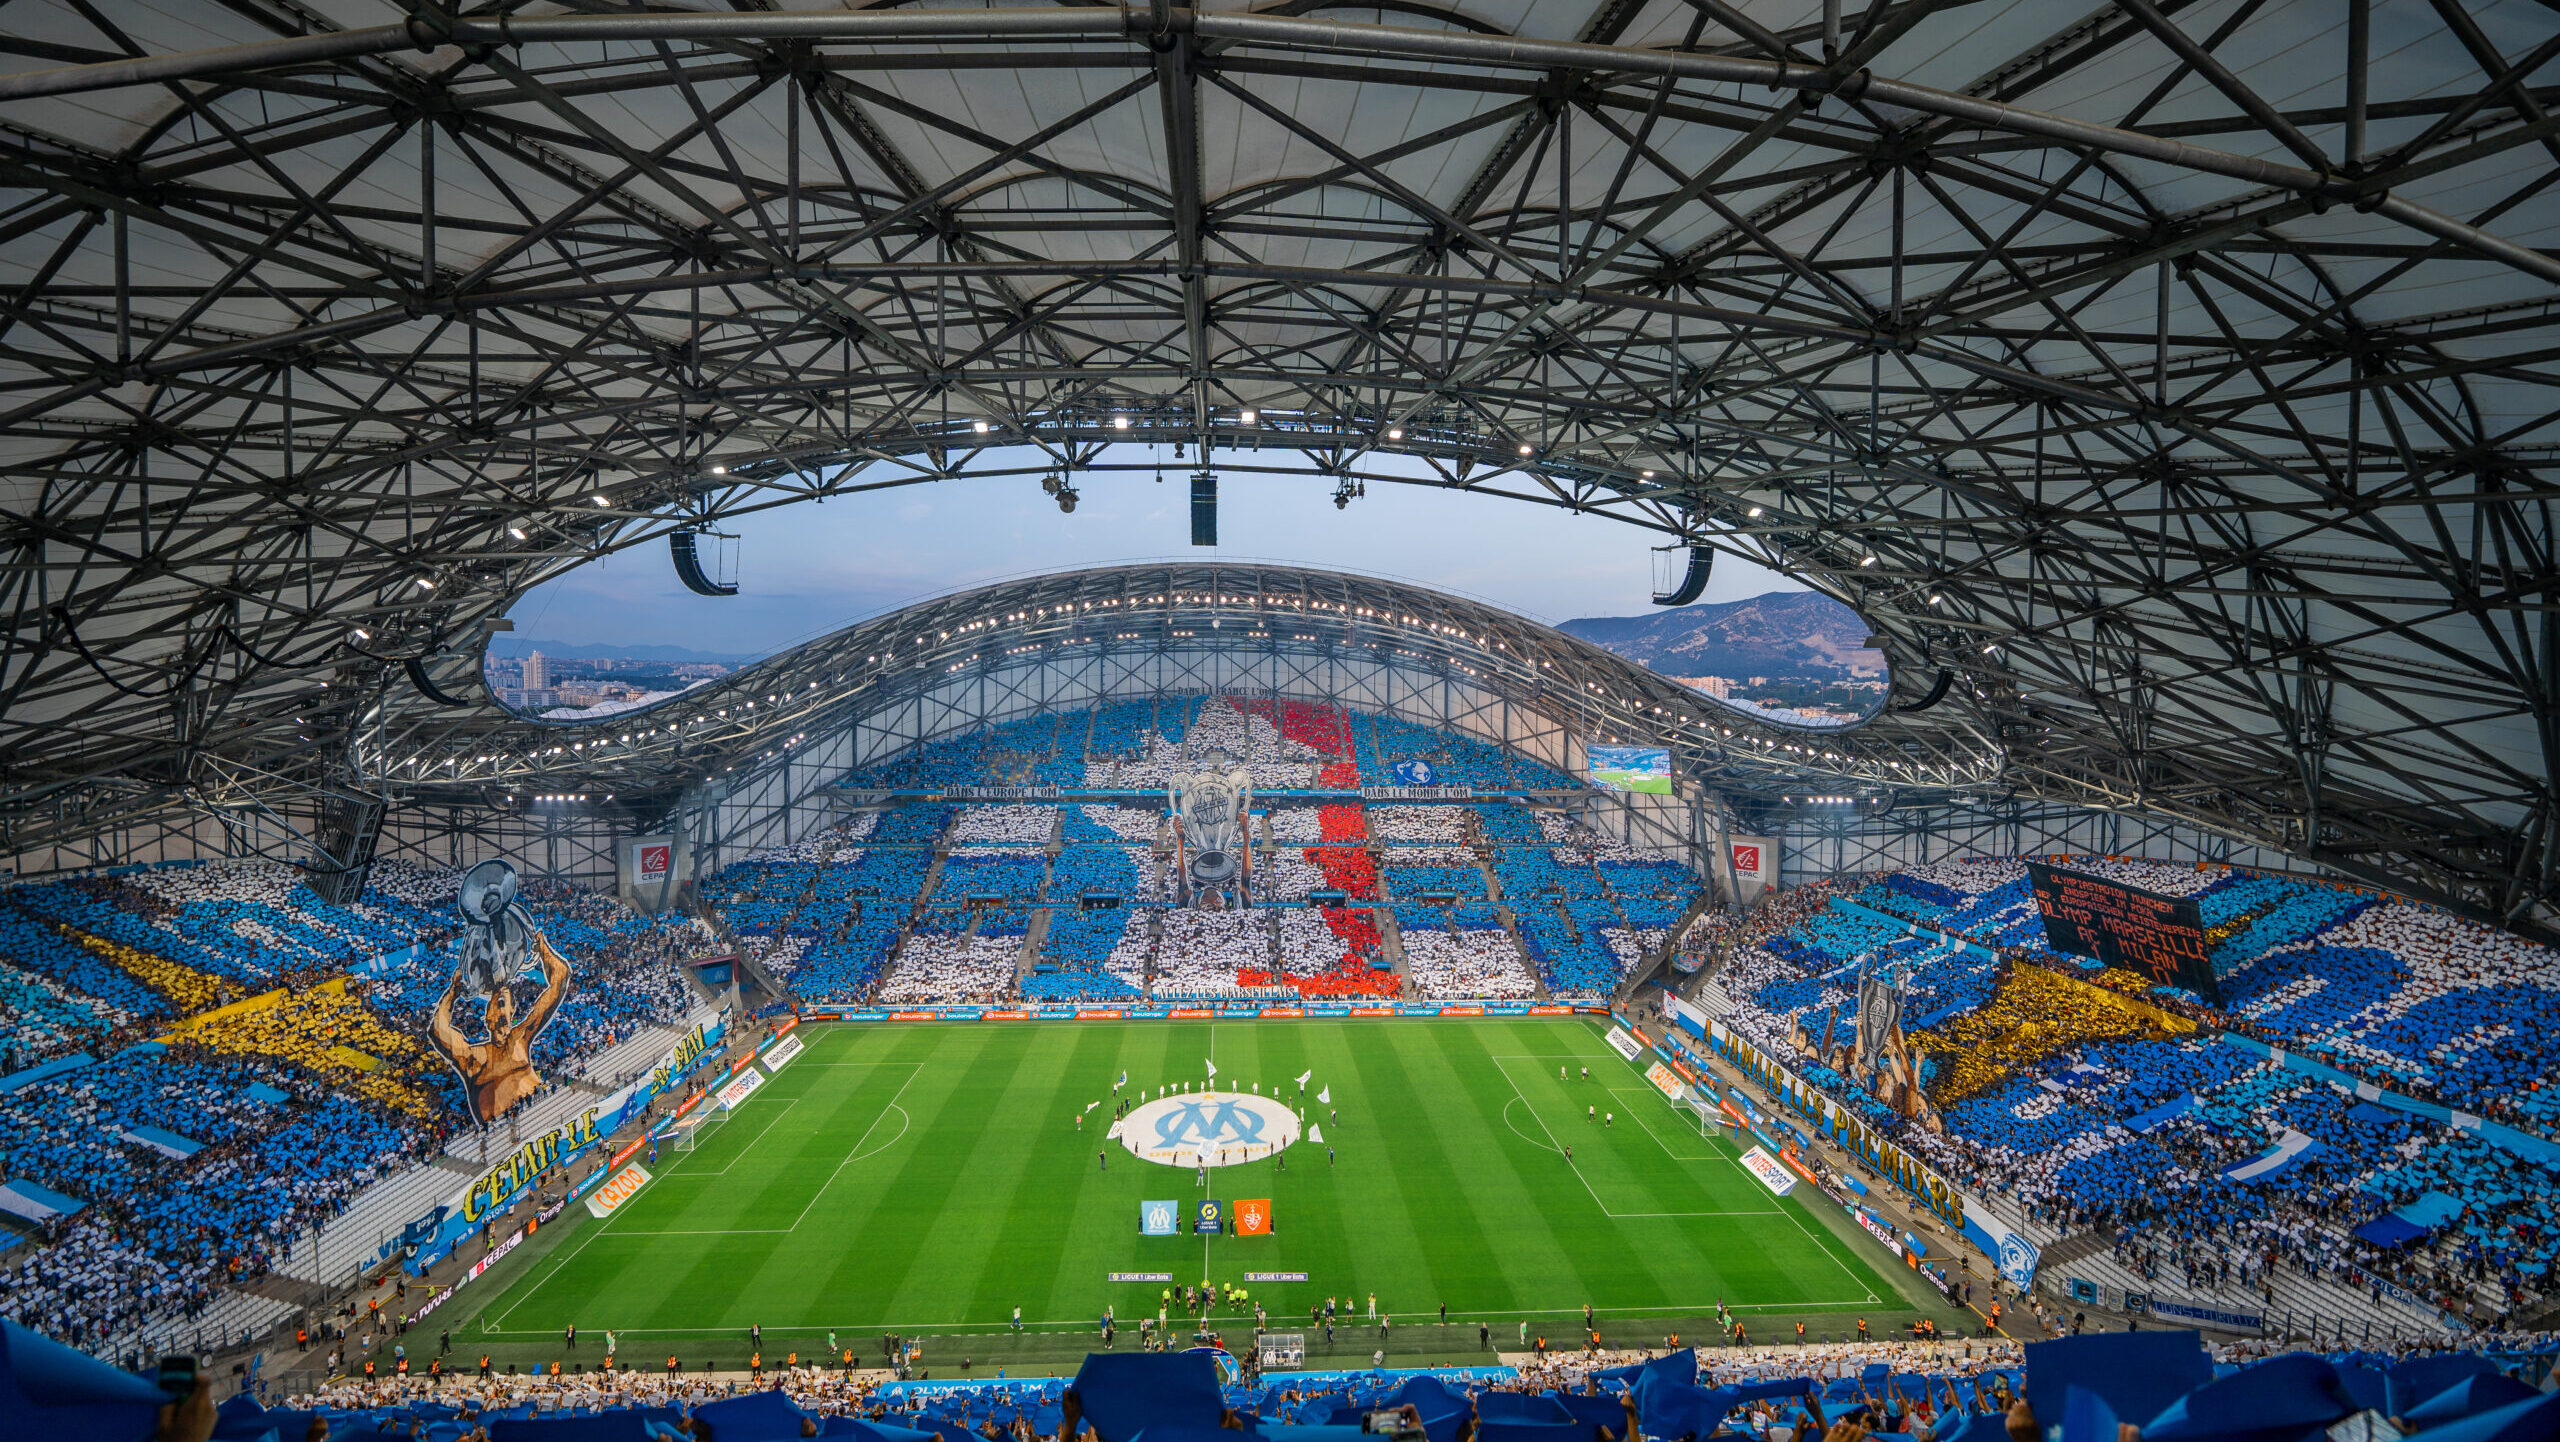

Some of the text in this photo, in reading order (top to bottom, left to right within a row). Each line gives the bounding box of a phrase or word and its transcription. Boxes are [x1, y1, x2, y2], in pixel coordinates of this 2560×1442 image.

[946, 787, 1057, 797] DANS L'EUROPE L'OM
[1364, 788, 1389, 798] DANS
[1392, 788, 1403, 798] LE
[1408, 788, 1440, 798] MONDE
[1444, 788, 1468, 798] L'OM
[641, 873, 667, 881] CEPA
[2077, 925, 2179, 973] AC MILAN
[1157, 985, 1296, 999] ALLEZ LES MARSEILLAIS
[565, 1107, 601, 1152] LE
[673, 1023, 707, 1073] MAI
[1703, 1018, 1966, 1230] A JAMAIS LES PREMIERS
[1748, 1153, 1791, 1190] INTERSPORT
[595, 1168, 645, 1209] CAZOO
[1868, 1221, 1894, 1250] CEPAC
[486, 1237, 515, 1266] CEPAC
[1920, 1263, 1949, 1294] Orange
